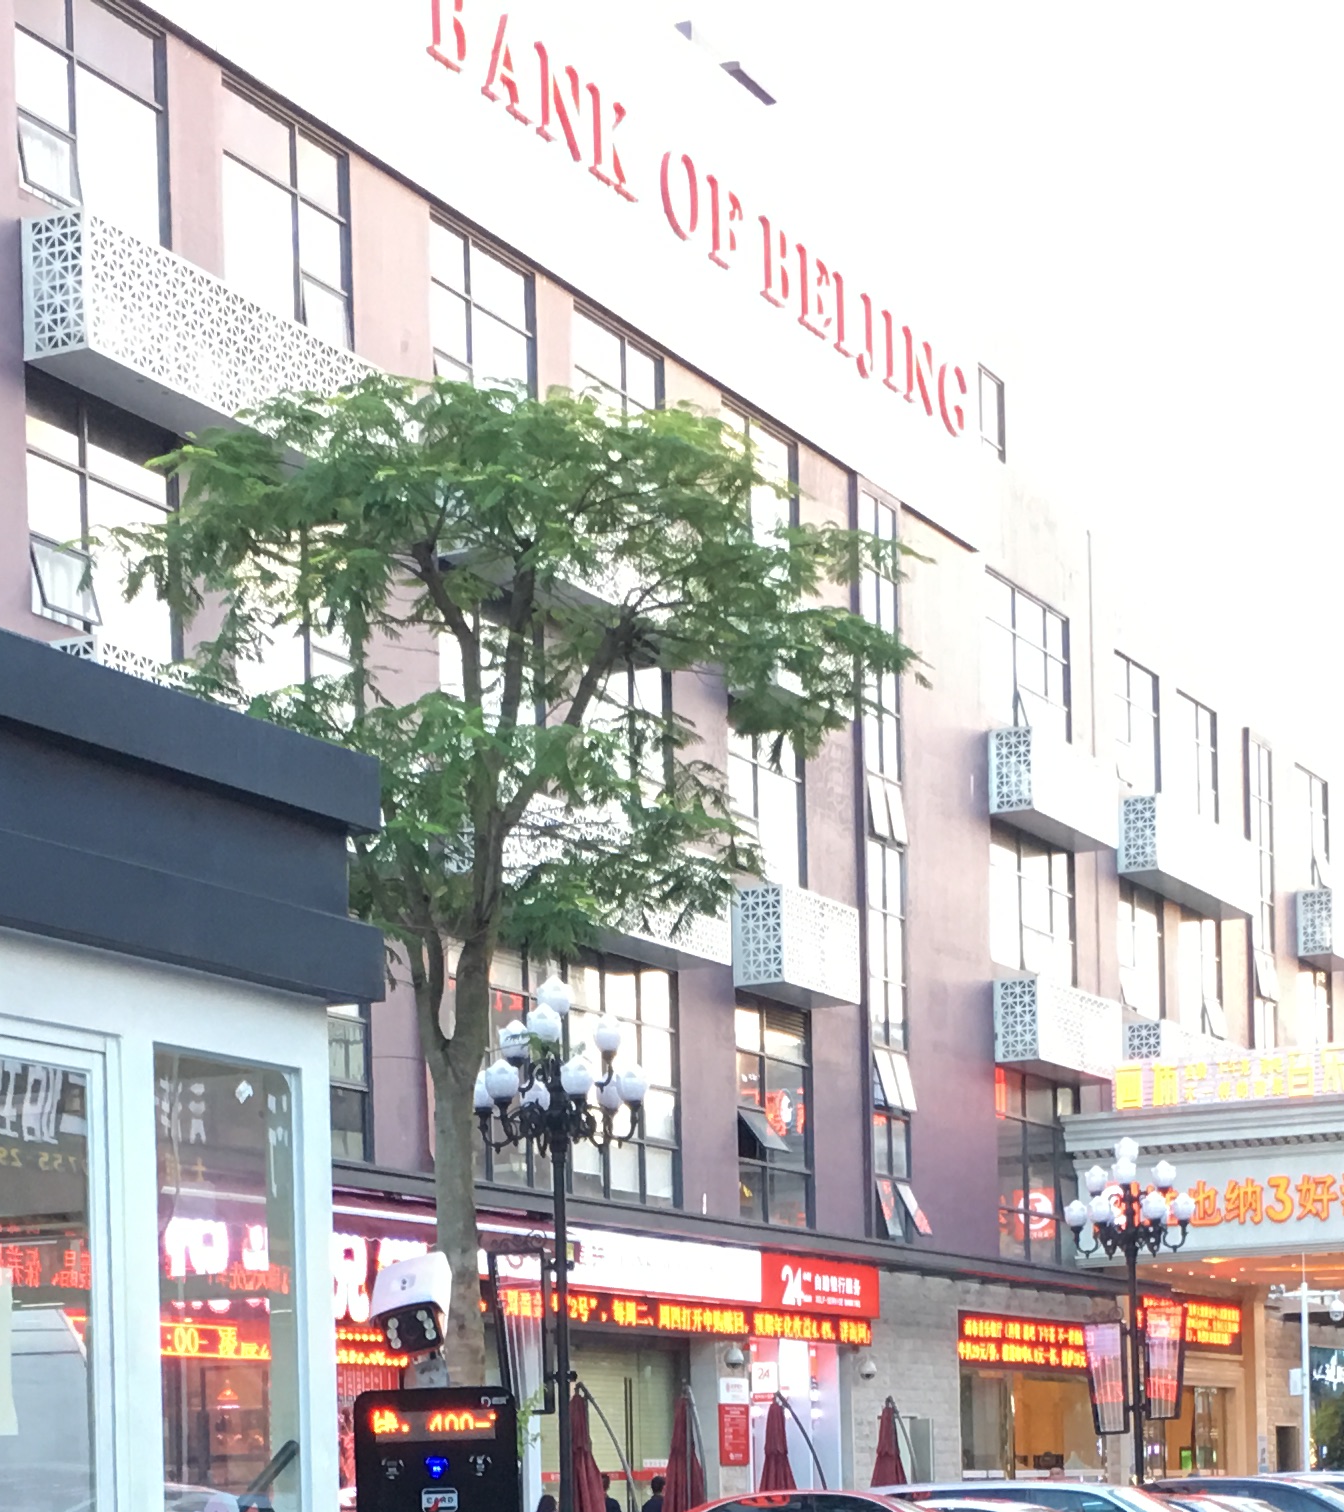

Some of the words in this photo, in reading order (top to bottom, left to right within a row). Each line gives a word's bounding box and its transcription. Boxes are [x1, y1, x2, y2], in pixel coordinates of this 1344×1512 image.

[426, 0, 639, 203] BANK
[658, 150, 744, 270] OF
[758, 214, 970, 437] BEIJING
